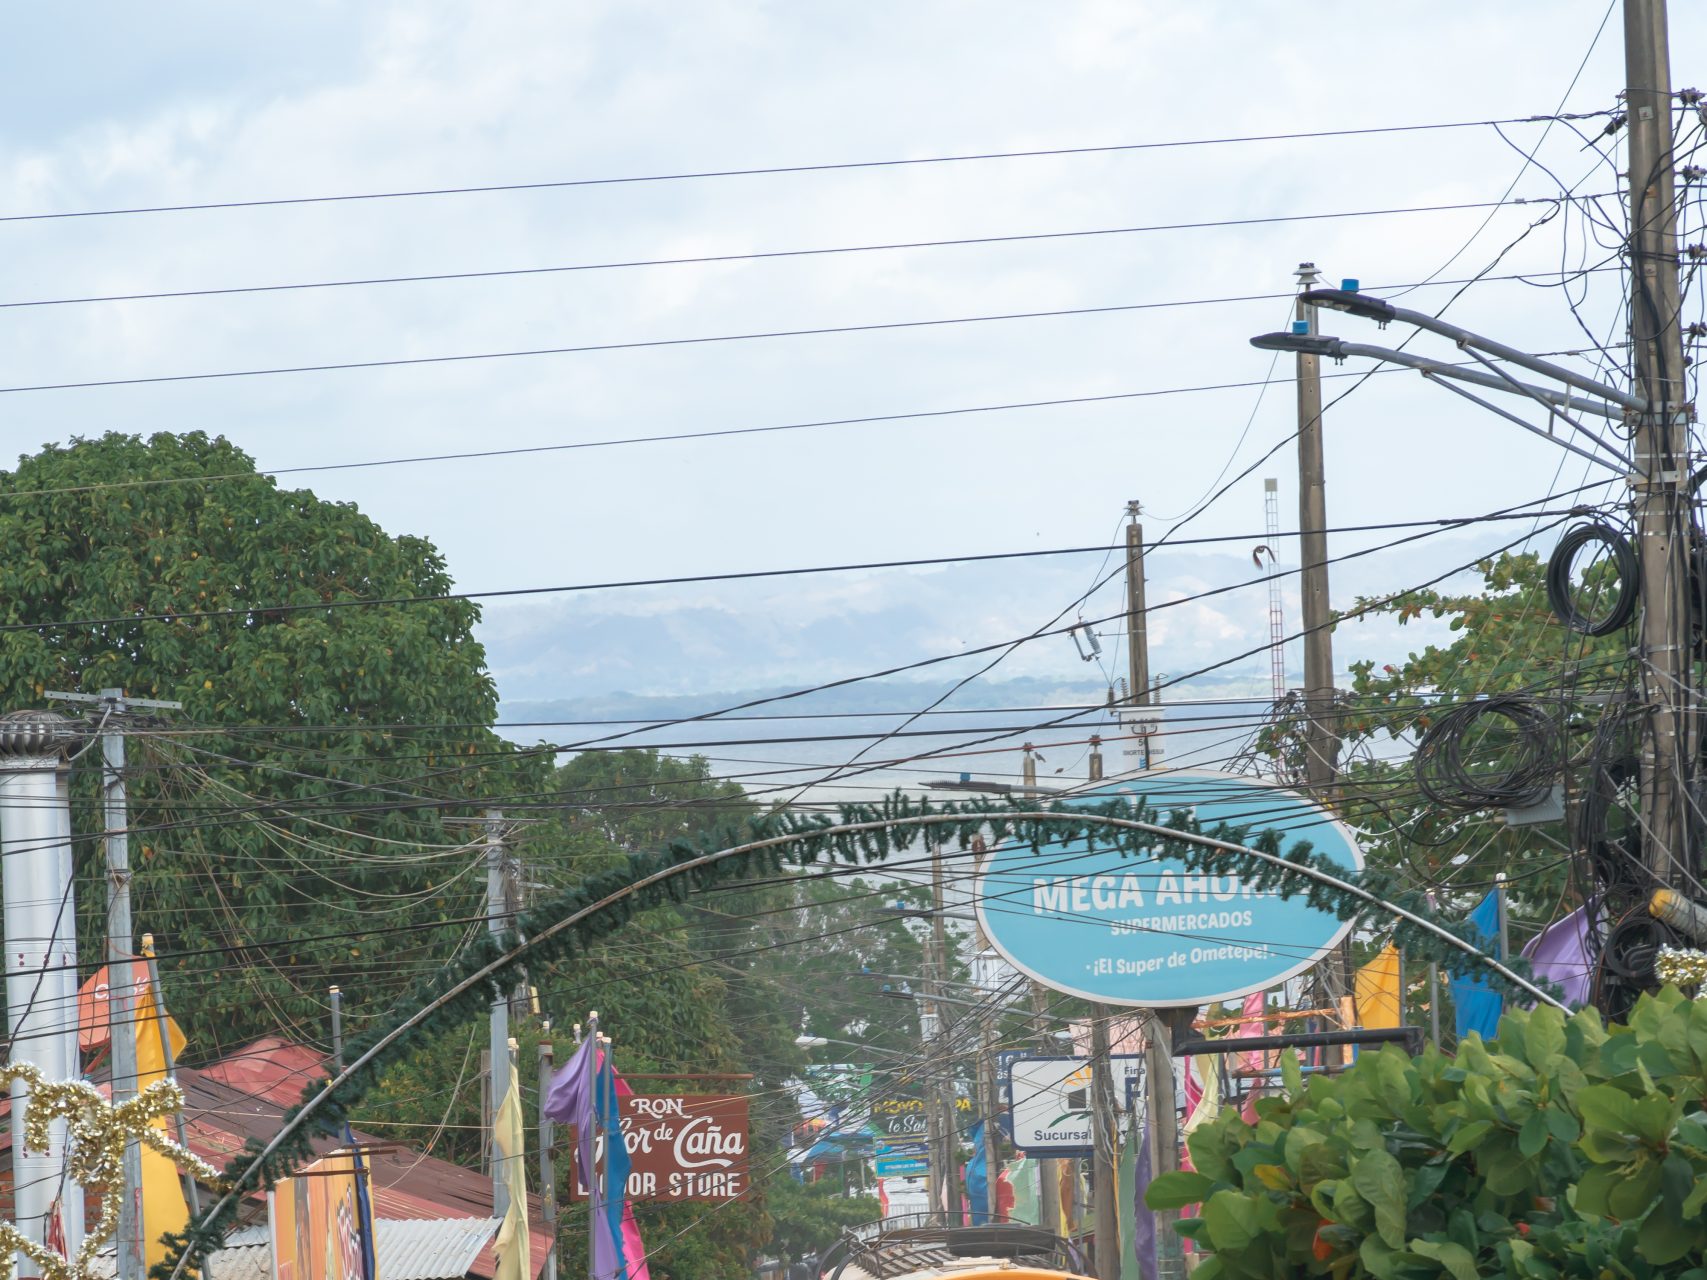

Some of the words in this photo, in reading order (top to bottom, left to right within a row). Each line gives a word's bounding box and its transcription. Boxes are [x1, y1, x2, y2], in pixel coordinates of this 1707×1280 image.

[1033, 872, 1144, 914] MEGA
[1110, 910, 1253, 936] SUPERMERCADOS
[1116, 955, 1164, 977] Super
[1167, 949, 1186, 968] de
[1190, 943, 1268, 965] Ometepe!
[629, 1098, 693, 1119] RON
[653, 1122, 674, 1141] de
[673, 1115, 745, 1168] Caña
[1034, 1129, 1093, 1141] Sucursal
[668, 1172, 741, 1197] STORE
